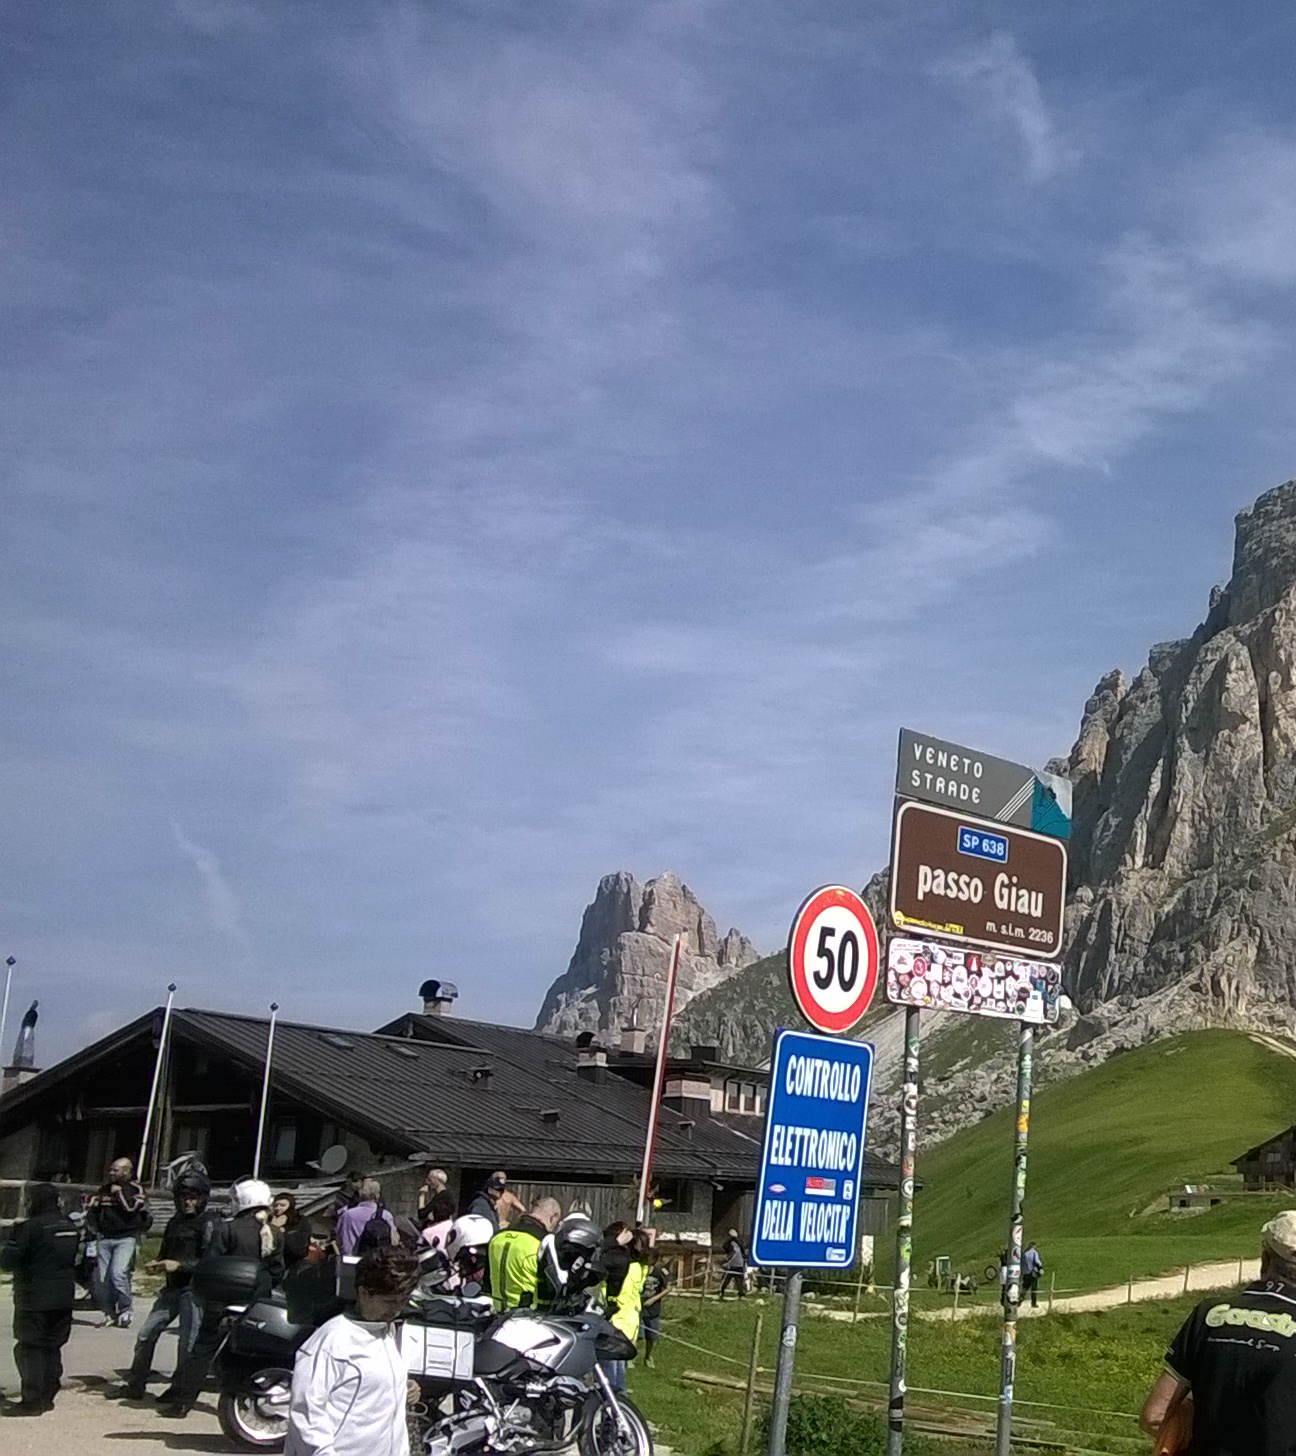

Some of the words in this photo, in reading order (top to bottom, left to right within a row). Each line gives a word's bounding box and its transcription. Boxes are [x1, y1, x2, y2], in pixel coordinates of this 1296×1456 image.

[913, 742, 983, 779] VENETO
[910, 771, 981, 804] STRADE
[962, 833, 980, 849] SP
[982, 836, 1005, 856] 638
[917, 864, 983, 904] passo
[994, 872, 1044, 918] Giau
[1028, 927, 1053, 944] 2236
[813, 926, 859, 992] 50
[786, 1055, 861, 1104] CONTROLLO
[769, 1124, 857, 1172] ELETTRONICO
[761, 1199, 795, 1242] DELLA
[1265, 1280, 1285, 1293] 97
